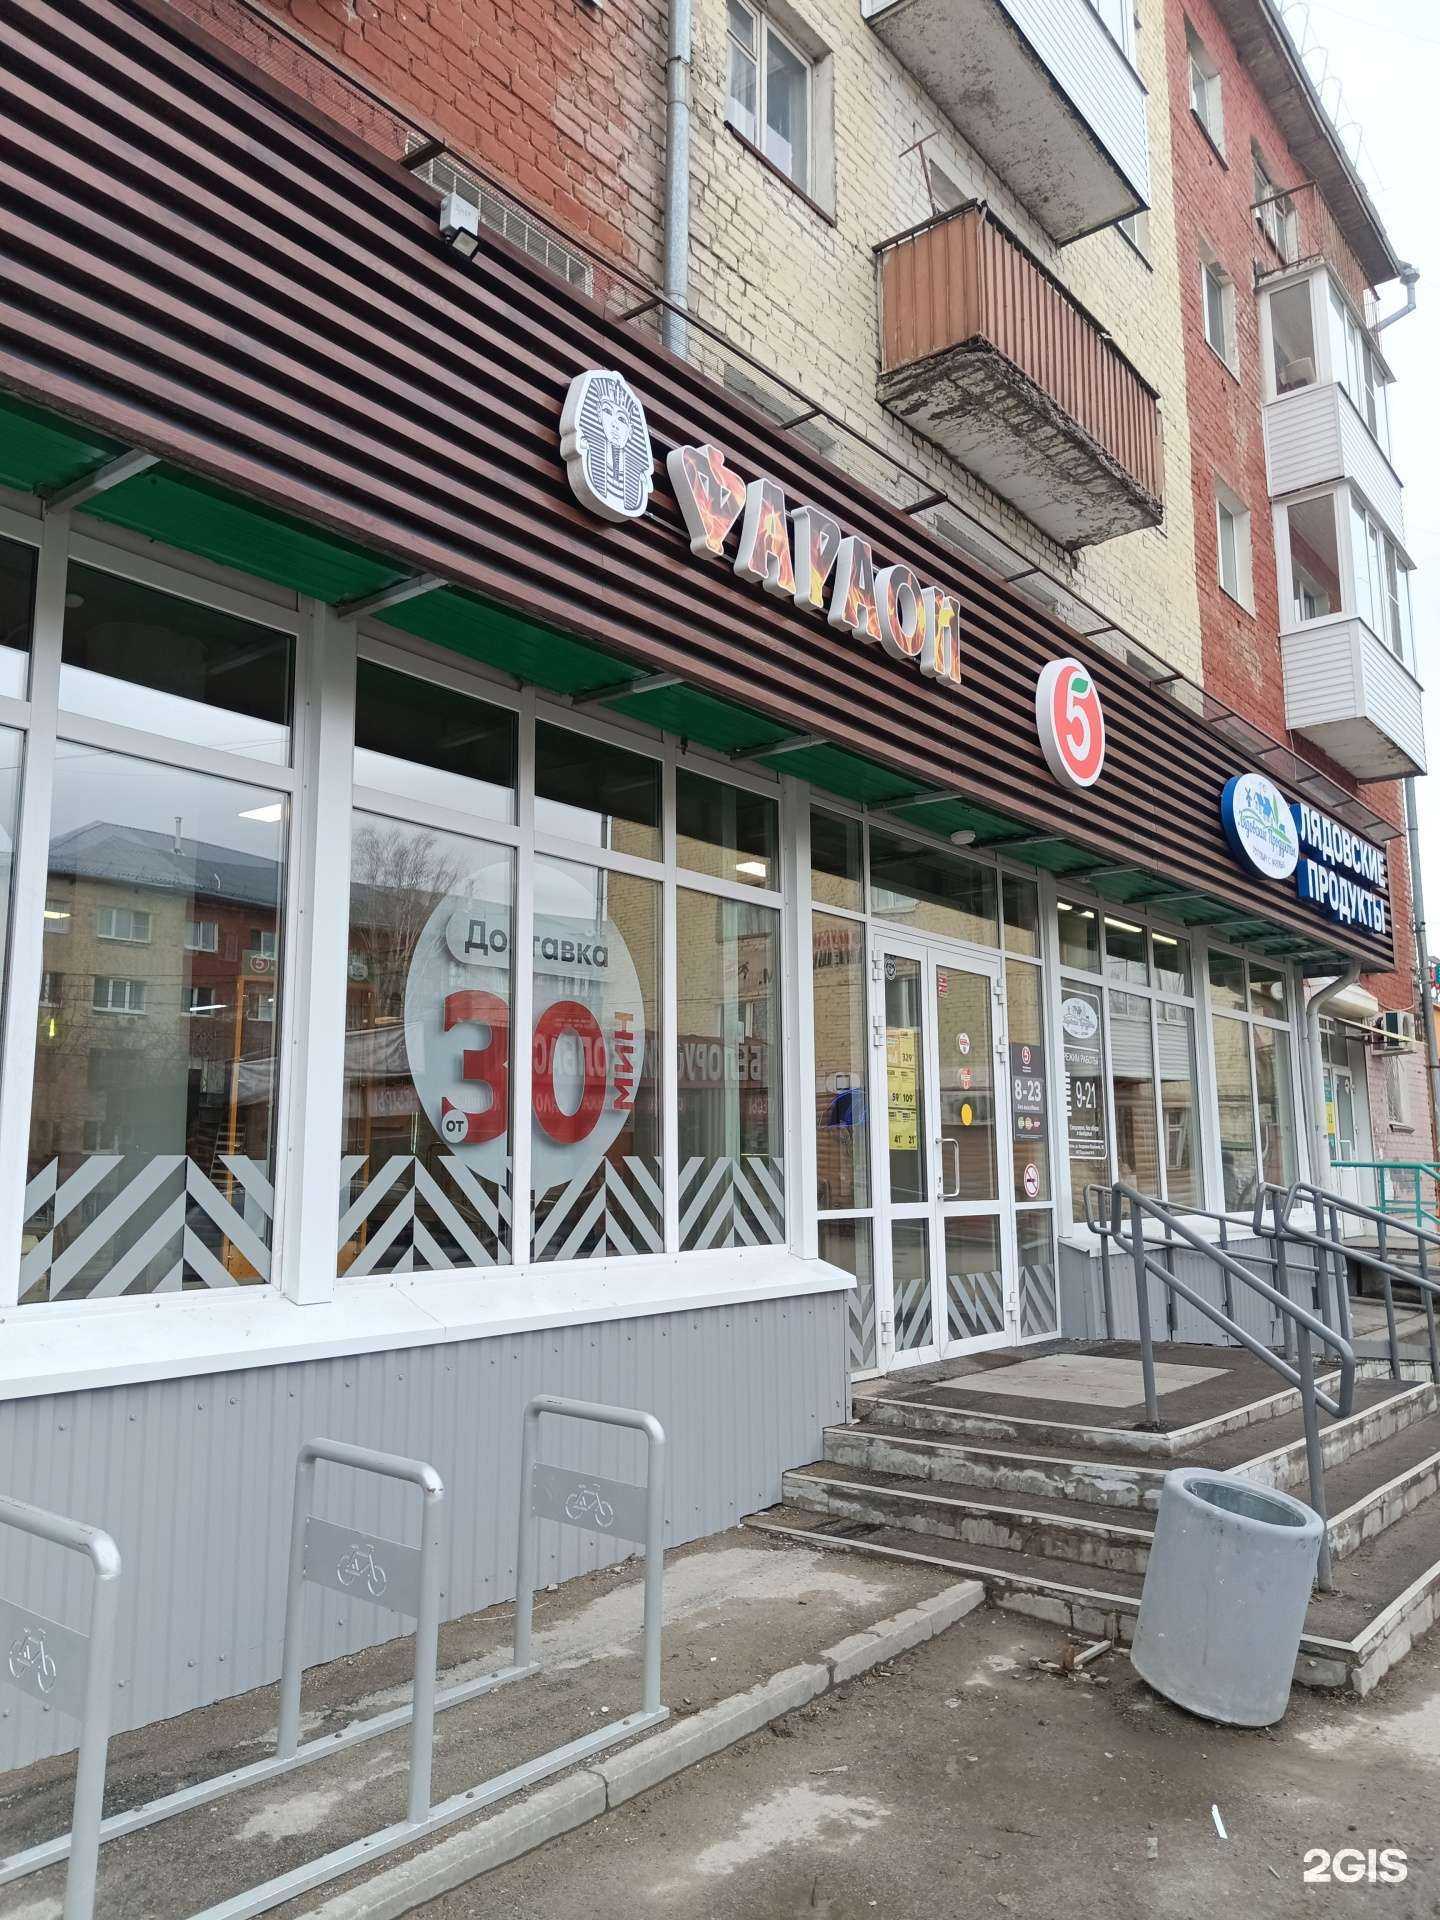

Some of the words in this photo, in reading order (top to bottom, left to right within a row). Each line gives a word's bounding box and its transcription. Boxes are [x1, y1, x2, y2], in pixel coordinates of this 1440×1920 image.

[667, 443, 962, 686] ФАРАОН
[1064, 669, 1094, 763] 5
[1299, 802, 1386, 889] ЛЯДОВСКИЕ
[1306, 858, 1386, 934] ПРОДУКТЫ
[464, 919, 609, 968] Дотавка
[441, 988, 608, 1145] 30
[1014, 1079, 1042, 1102] 8-23
[1075, 1080, 1097, 1109] 9-21
